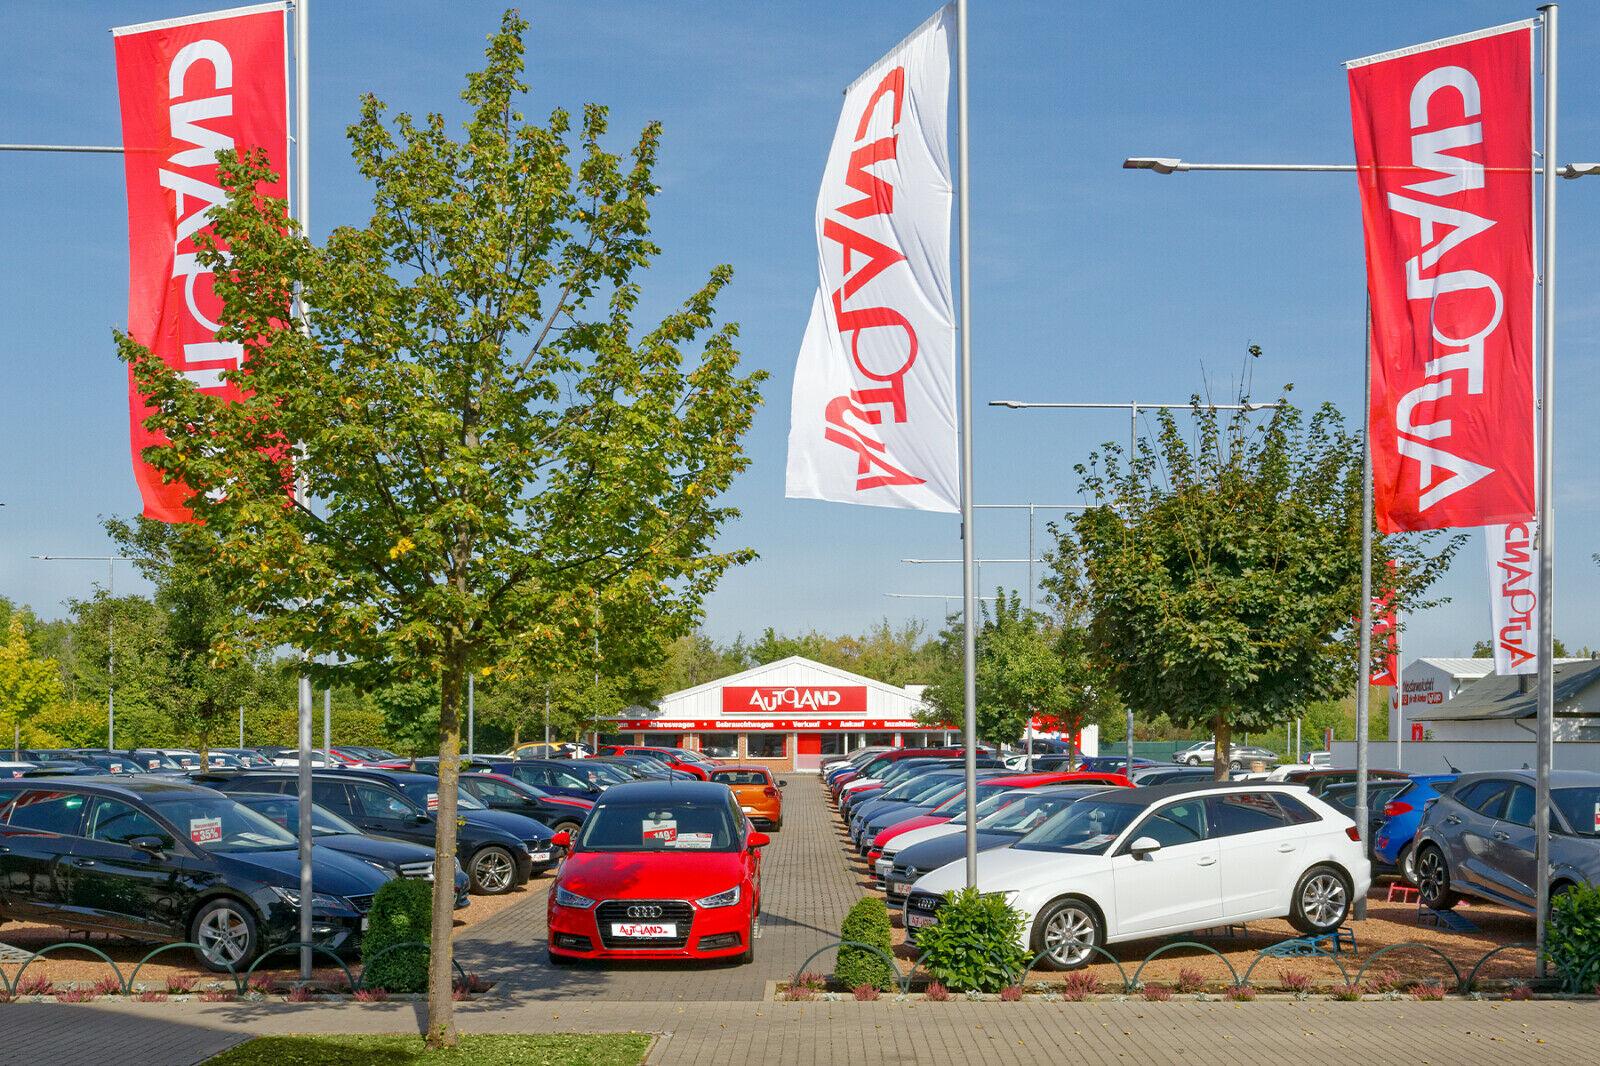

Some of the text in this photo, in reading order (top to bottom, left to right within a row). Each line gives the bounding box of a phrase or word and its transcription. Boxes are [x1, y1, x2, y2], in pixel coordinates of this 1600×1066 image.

[749, 687, 841, 711] AUTOLAND
[715, 720, 774, 730] Gebrauchtwagen
[792, 720, 821, 728] Verkauf
[839, 720, 866, 728] Ankauf
